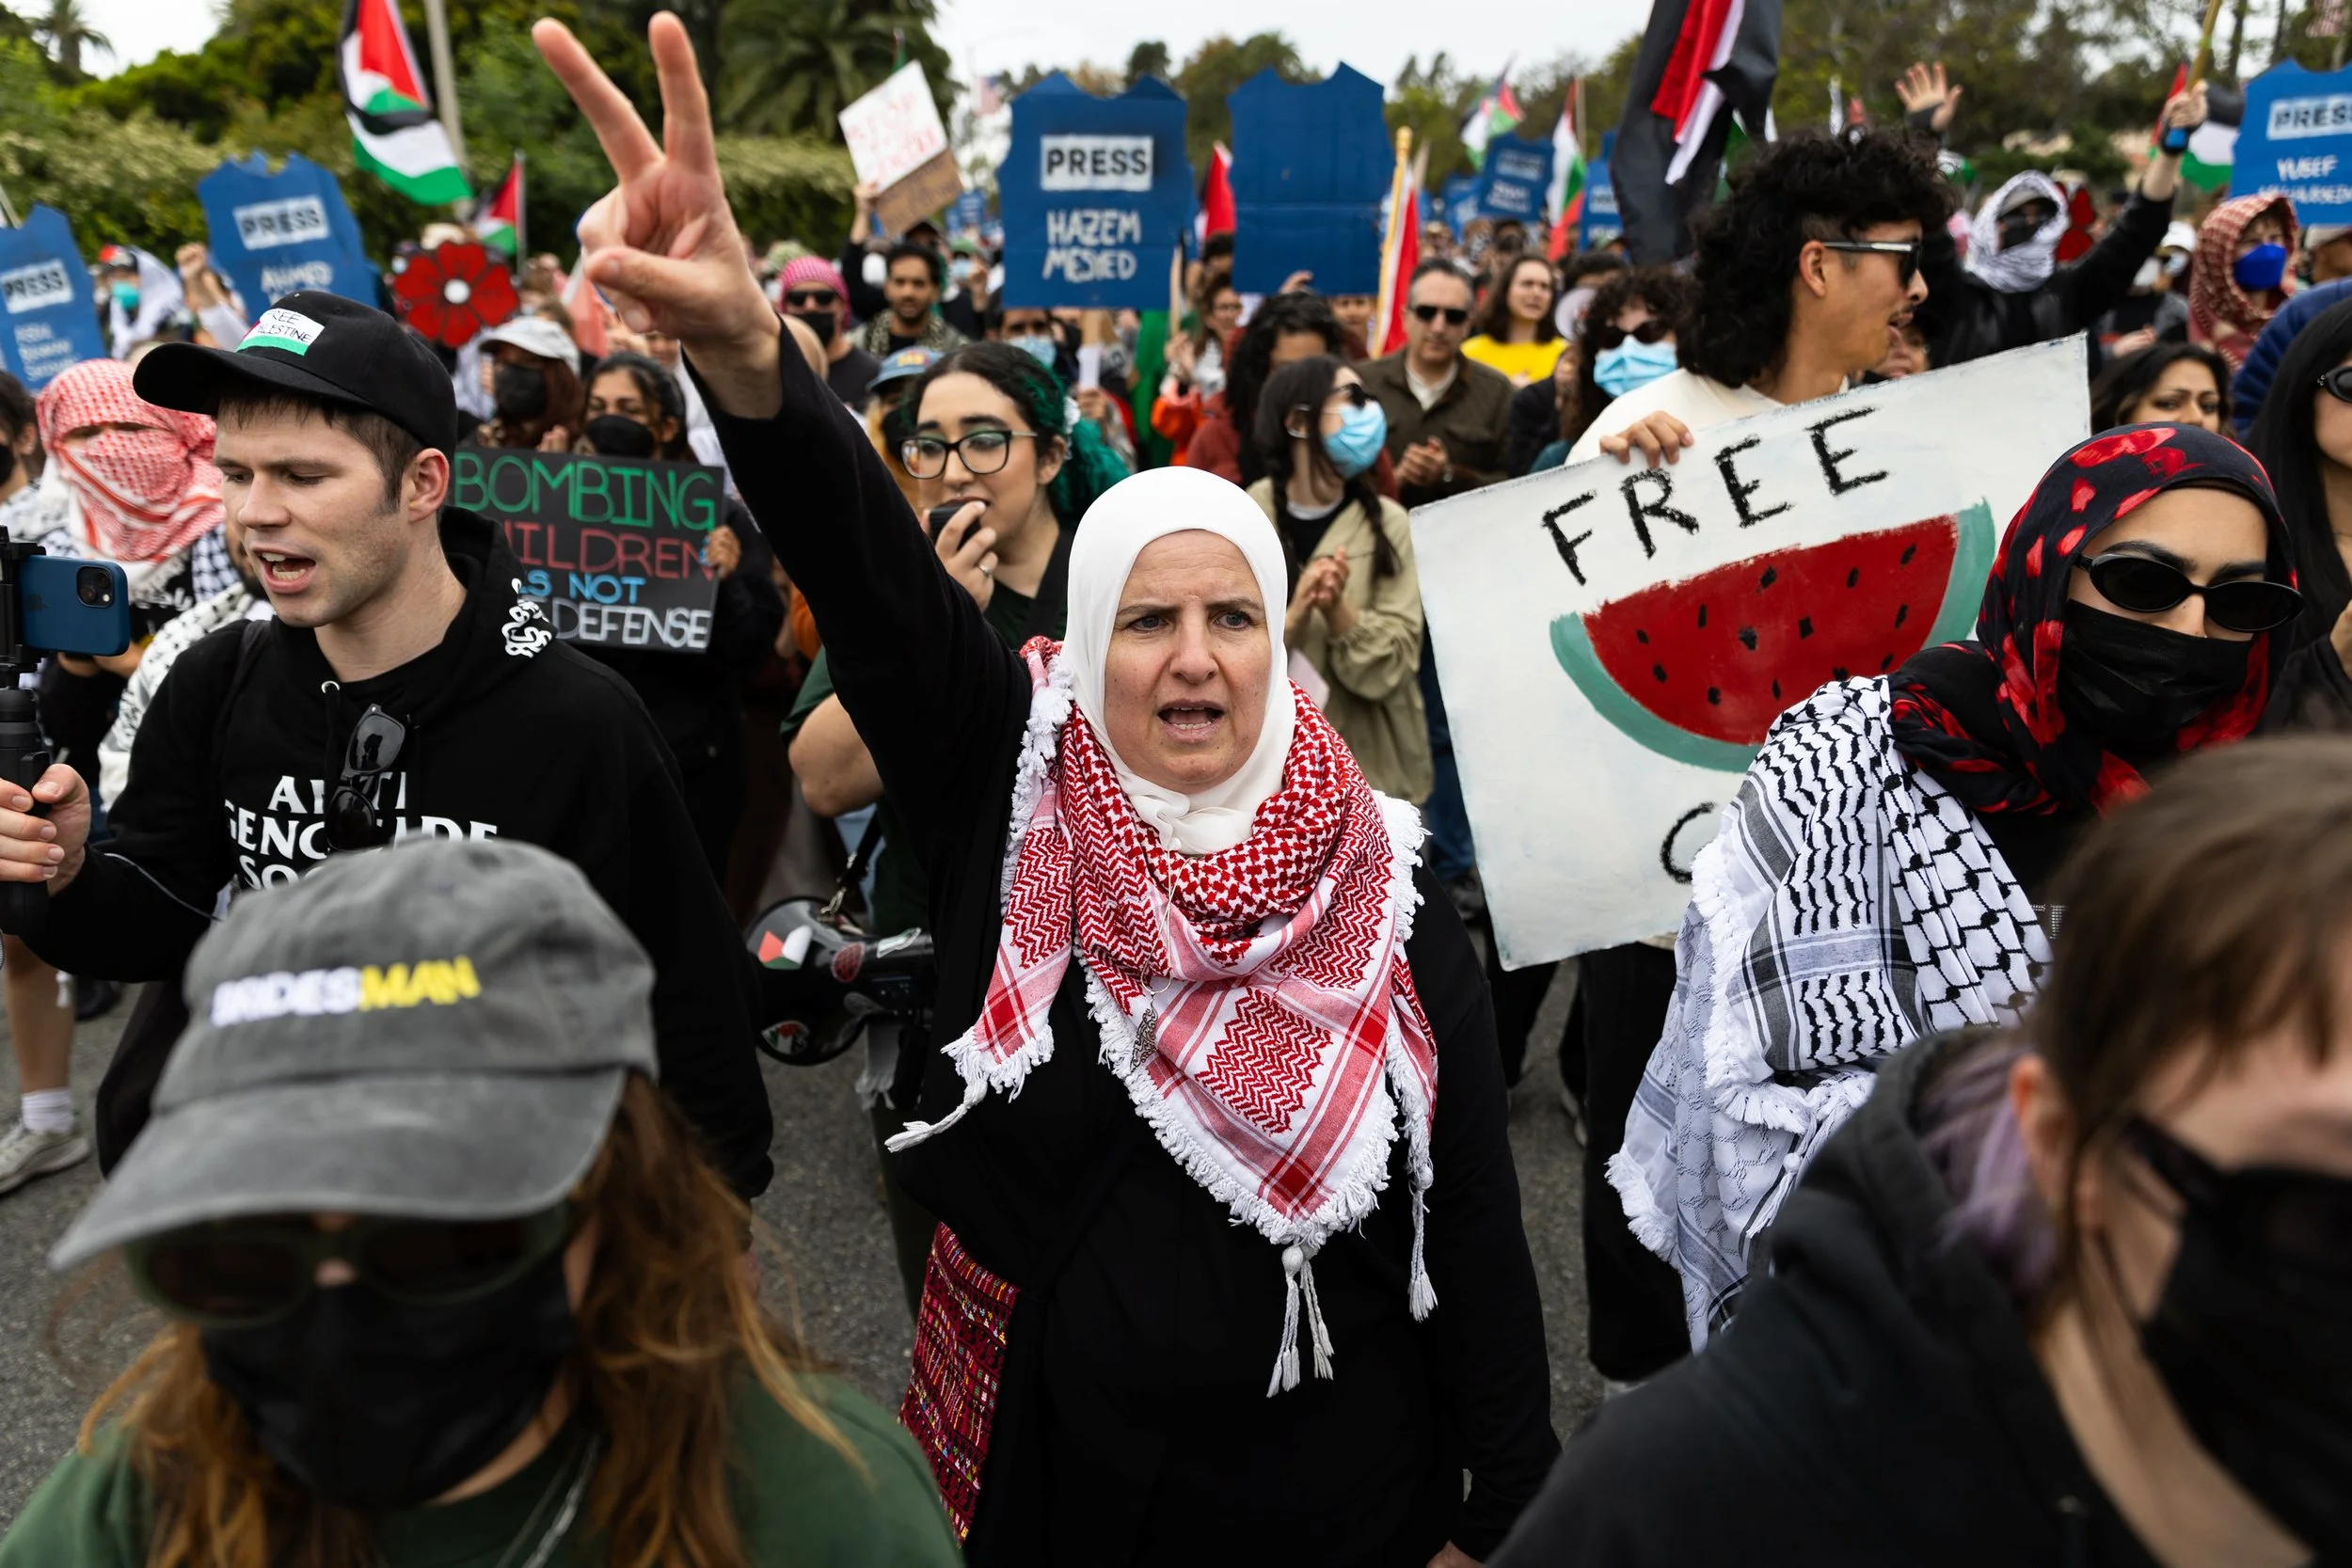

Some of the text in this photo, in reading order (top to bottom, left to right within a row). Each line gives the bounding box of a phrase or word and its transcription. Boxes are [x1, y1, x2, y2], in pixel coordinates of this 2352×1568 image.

[2275, 101, 2352, 130] PRES
[1046, 147, 1148, 177] PRESS
[242, 208, 321, 235] PRESS
[1045, 208, 1141, 247] HAZEM
[3, 269, 65, 298] PRESS
[453, 451, 716, 532] BOMBING
[1541, 405, 1890, 586] FREE
[504, 519, 715, 581] ILDREN
[519, 568, 645, 605] S NOT
[551, 596, 713, 649] DEFENSE
